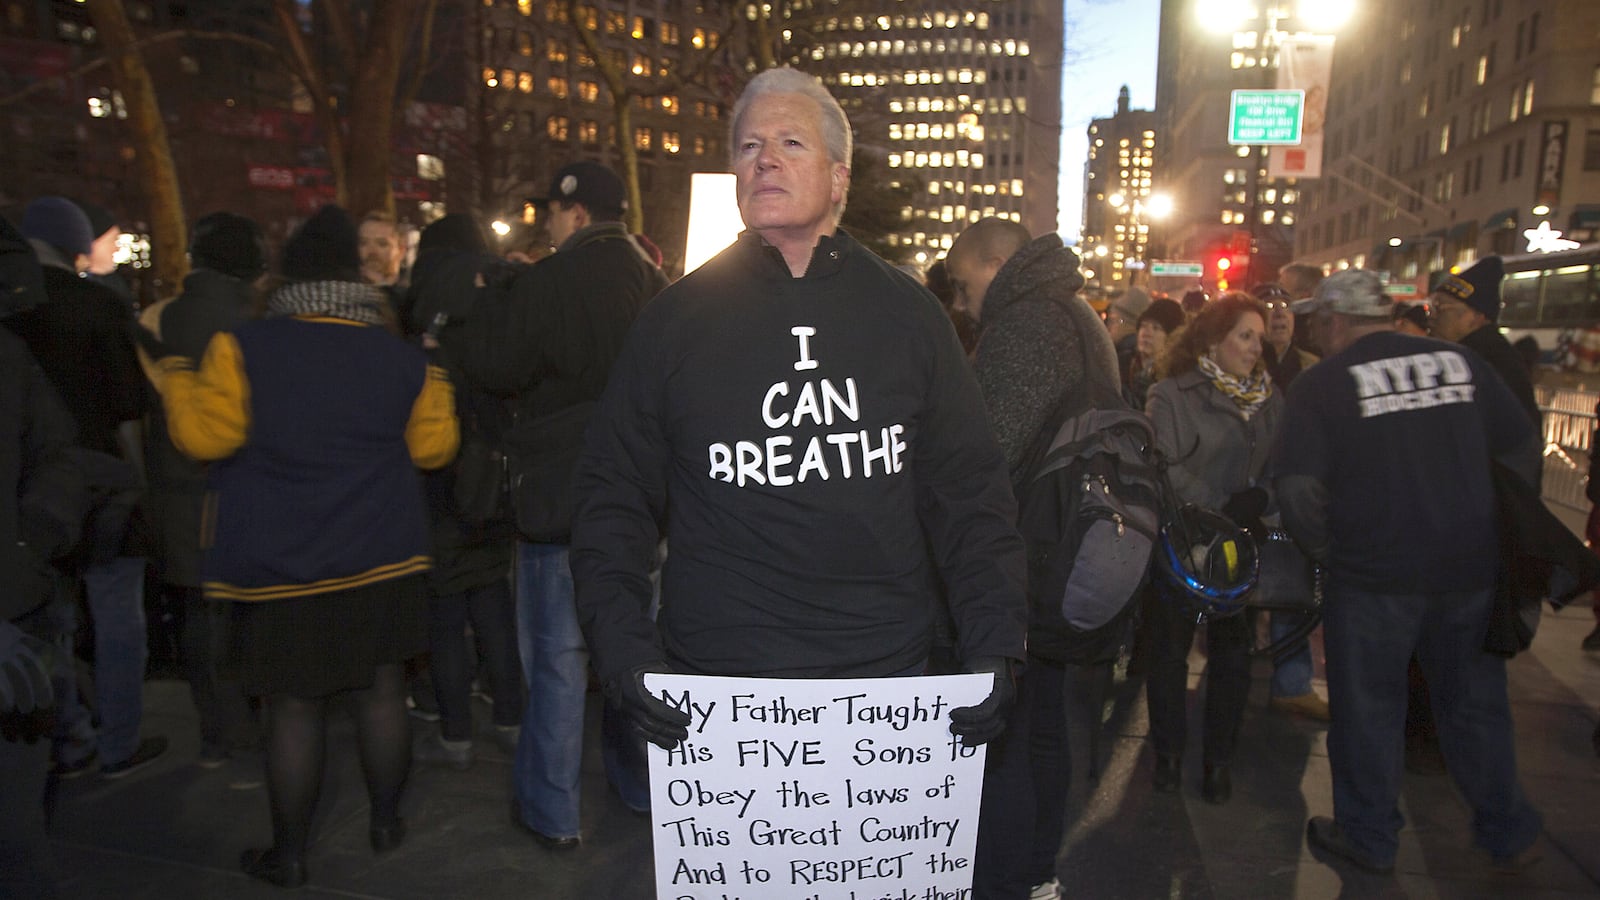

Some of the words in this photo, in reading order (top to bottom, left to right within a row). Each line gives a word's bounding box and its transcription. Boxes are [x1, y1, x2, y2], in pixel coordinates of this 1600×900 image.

[1238, 128, 1266, 138] KEEP
[1267, 128, 1292, 138] LEFT
[790, 325, 819, 371] I
[1347, 350, 1473, 400] NYPD
[761, 377, 861, 429] CAN
[1358, 384, 1477, 418] HOCKEY
[708, 423, 907, 488] BREATHE
[661, 689, 717, 734] My
[731, 694, 827, 726] Father
[832, 693, 948, 731] Taught
[667, 740, 714, 767] His
[737, 739, 826, 768] FIVE
[852, 738, 932, 767] Sons
[947, 733, 977, 762] to
[668, 779, 757, 819] Obey
[776, 780, 831, 808] the
[845, 779, 910, 809] laws
[925, 774, 956, 799] of
[661, 816, 731, 847] This
[749, 819, 842, 846] Great
[860, 815, 960, 847] Country
[672, 858, 727, 885] And
[740, 860, 771, 884] to
[789, 851, 914, 885] RESPECT
[925, 852, 969, 874] the
